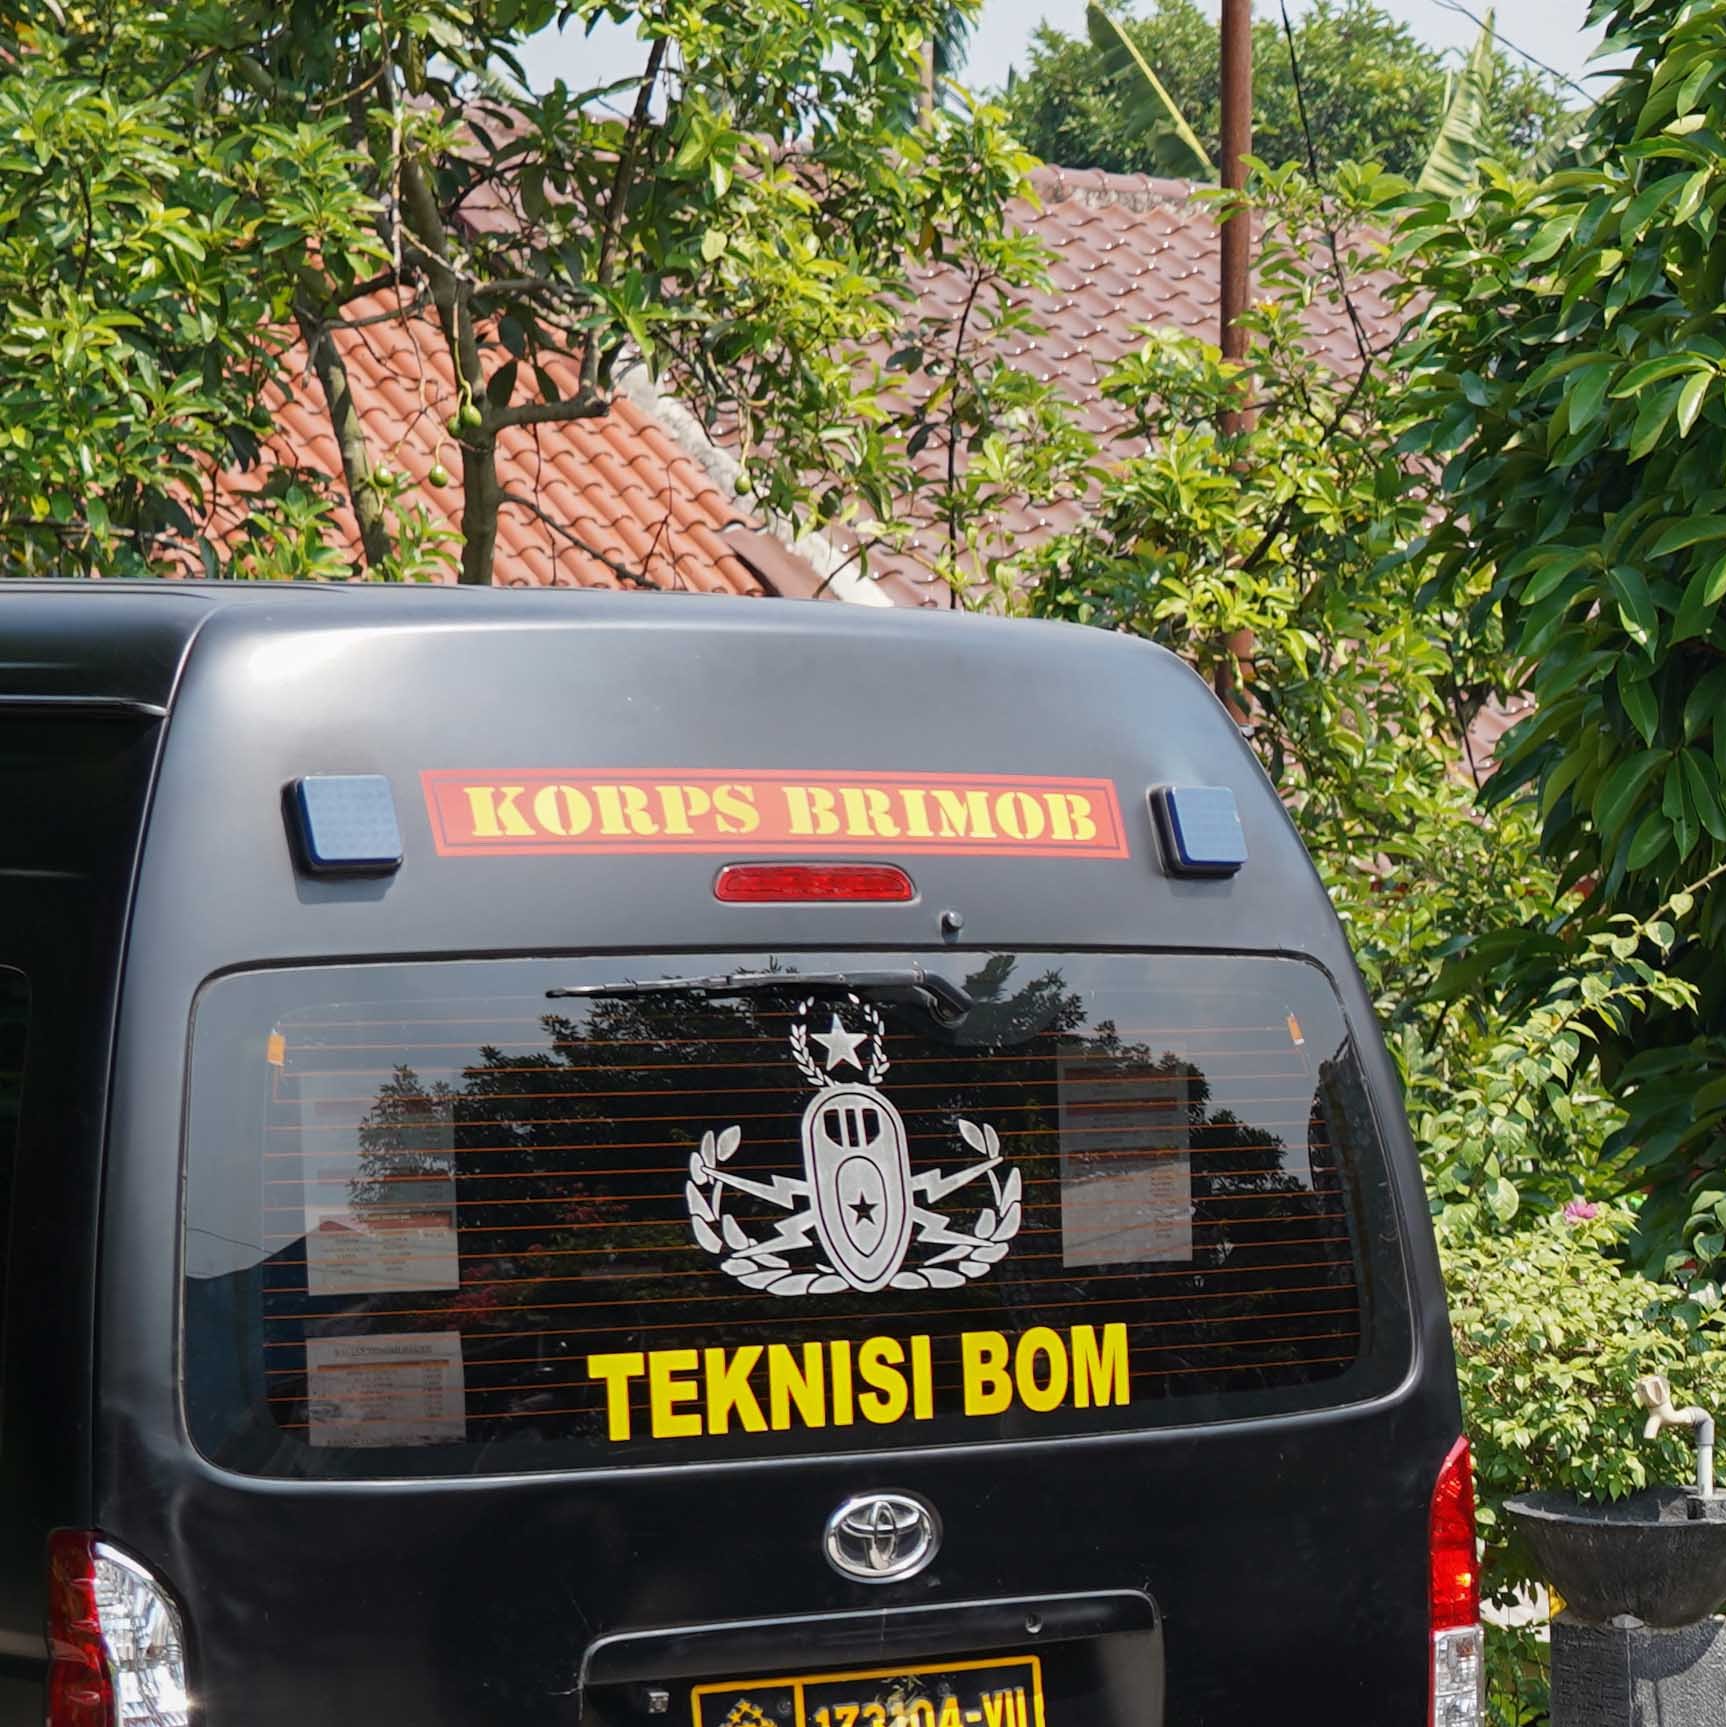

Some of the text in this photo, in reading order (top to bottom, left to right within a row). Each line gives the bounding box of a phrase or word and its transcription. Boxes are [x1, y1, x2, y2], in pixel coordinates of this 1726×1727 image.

[464, 784, 1098, 842] KORPS BRIMOB
[586, 1322, 1131, 1442] TEKNISI BOM
